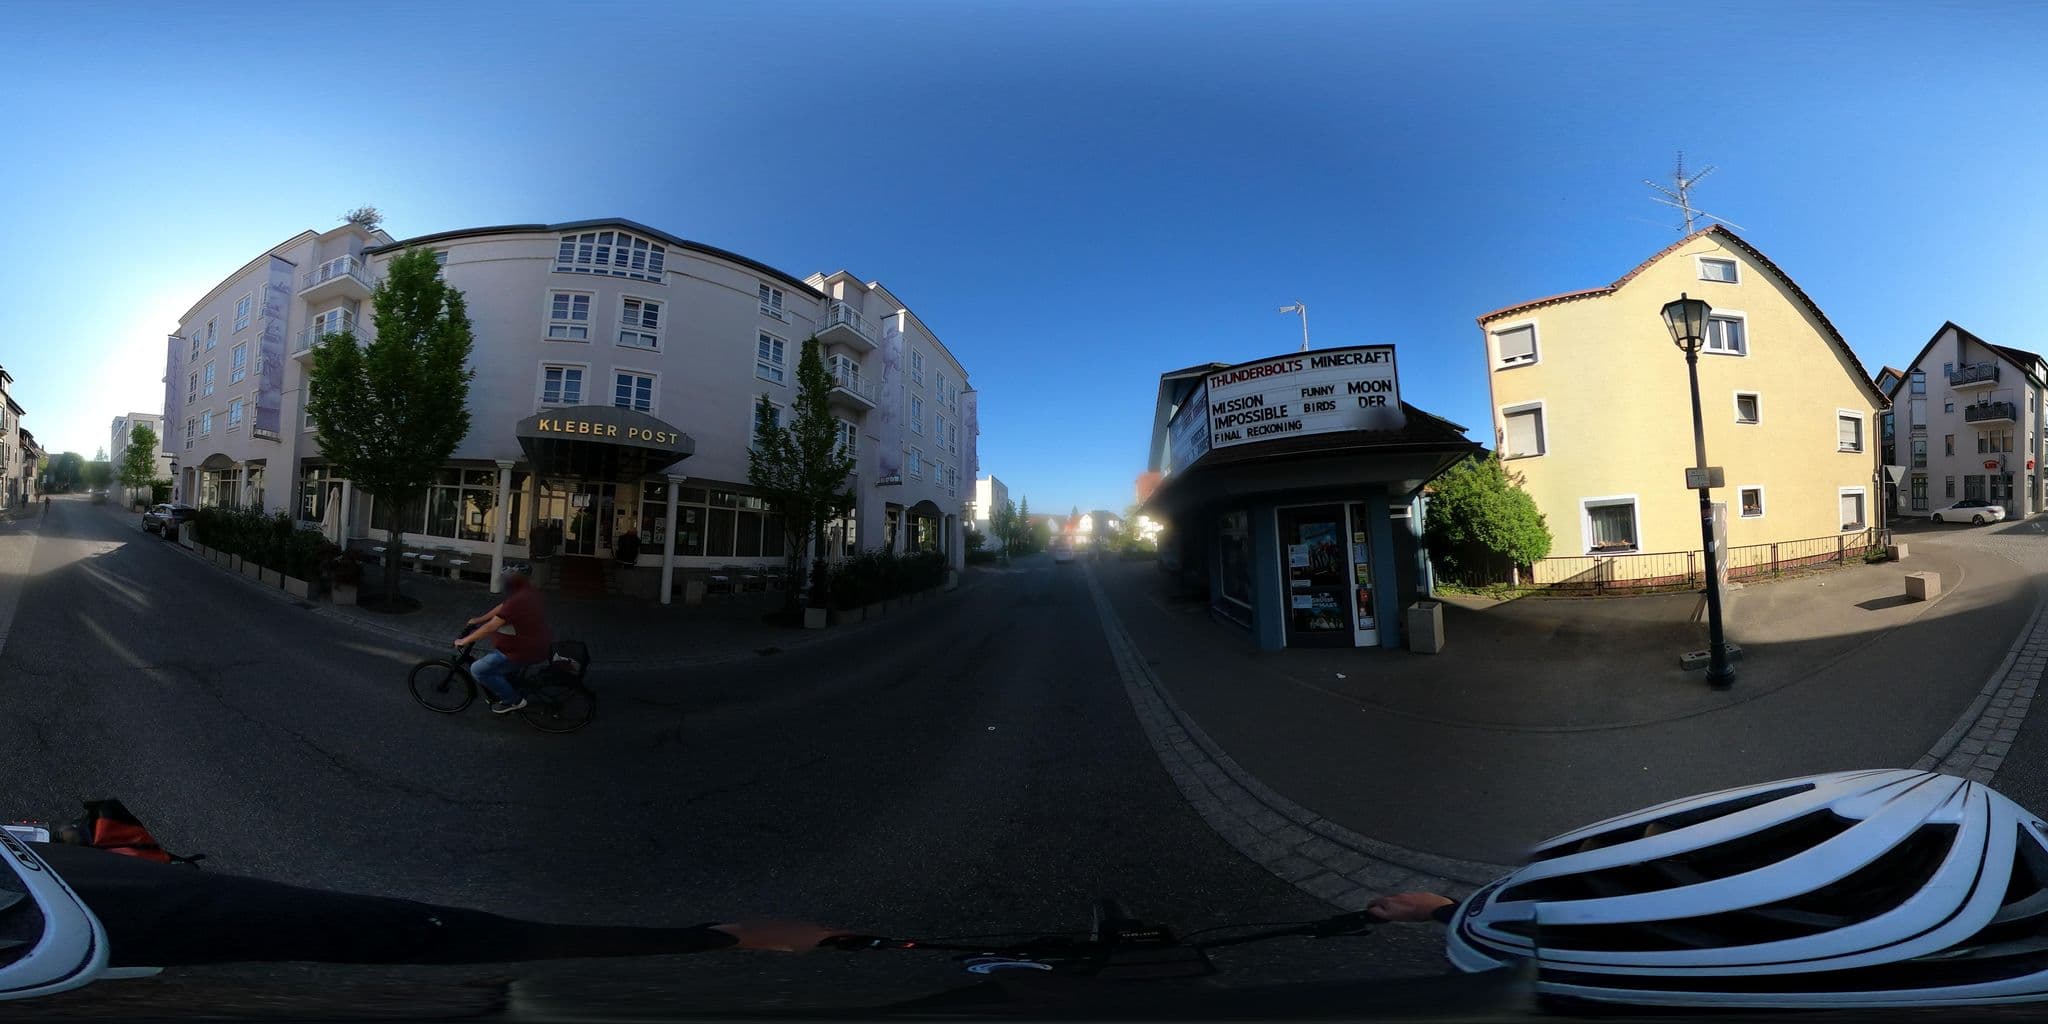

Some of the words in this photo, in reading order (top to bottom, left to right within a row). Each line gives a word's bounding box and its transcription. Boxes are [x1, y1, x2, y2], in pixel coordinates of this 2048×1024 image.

[1210, 360, 1303, 389] THUNDERBOLTS
[1311, 351, 1390, 369] MINECRAFT
[1301, 384, 1335, 398] FUNNY
[1347, 379, 1393, 395] MOON
[1212, 394, 1264, 416] MISSION
[1303, 400, 1336, 413] BIRDS
[1358, 395, 1387, 409] DER
[1214, 405, 1289, 430] IMPOSSIBLE
[539, 419, 617, 437] KLEBER
[629, 427, 678, 445] POST
[1214, 430, 1242, 443] FINAL
[1247, 420, 1303, 437] RECKONING
